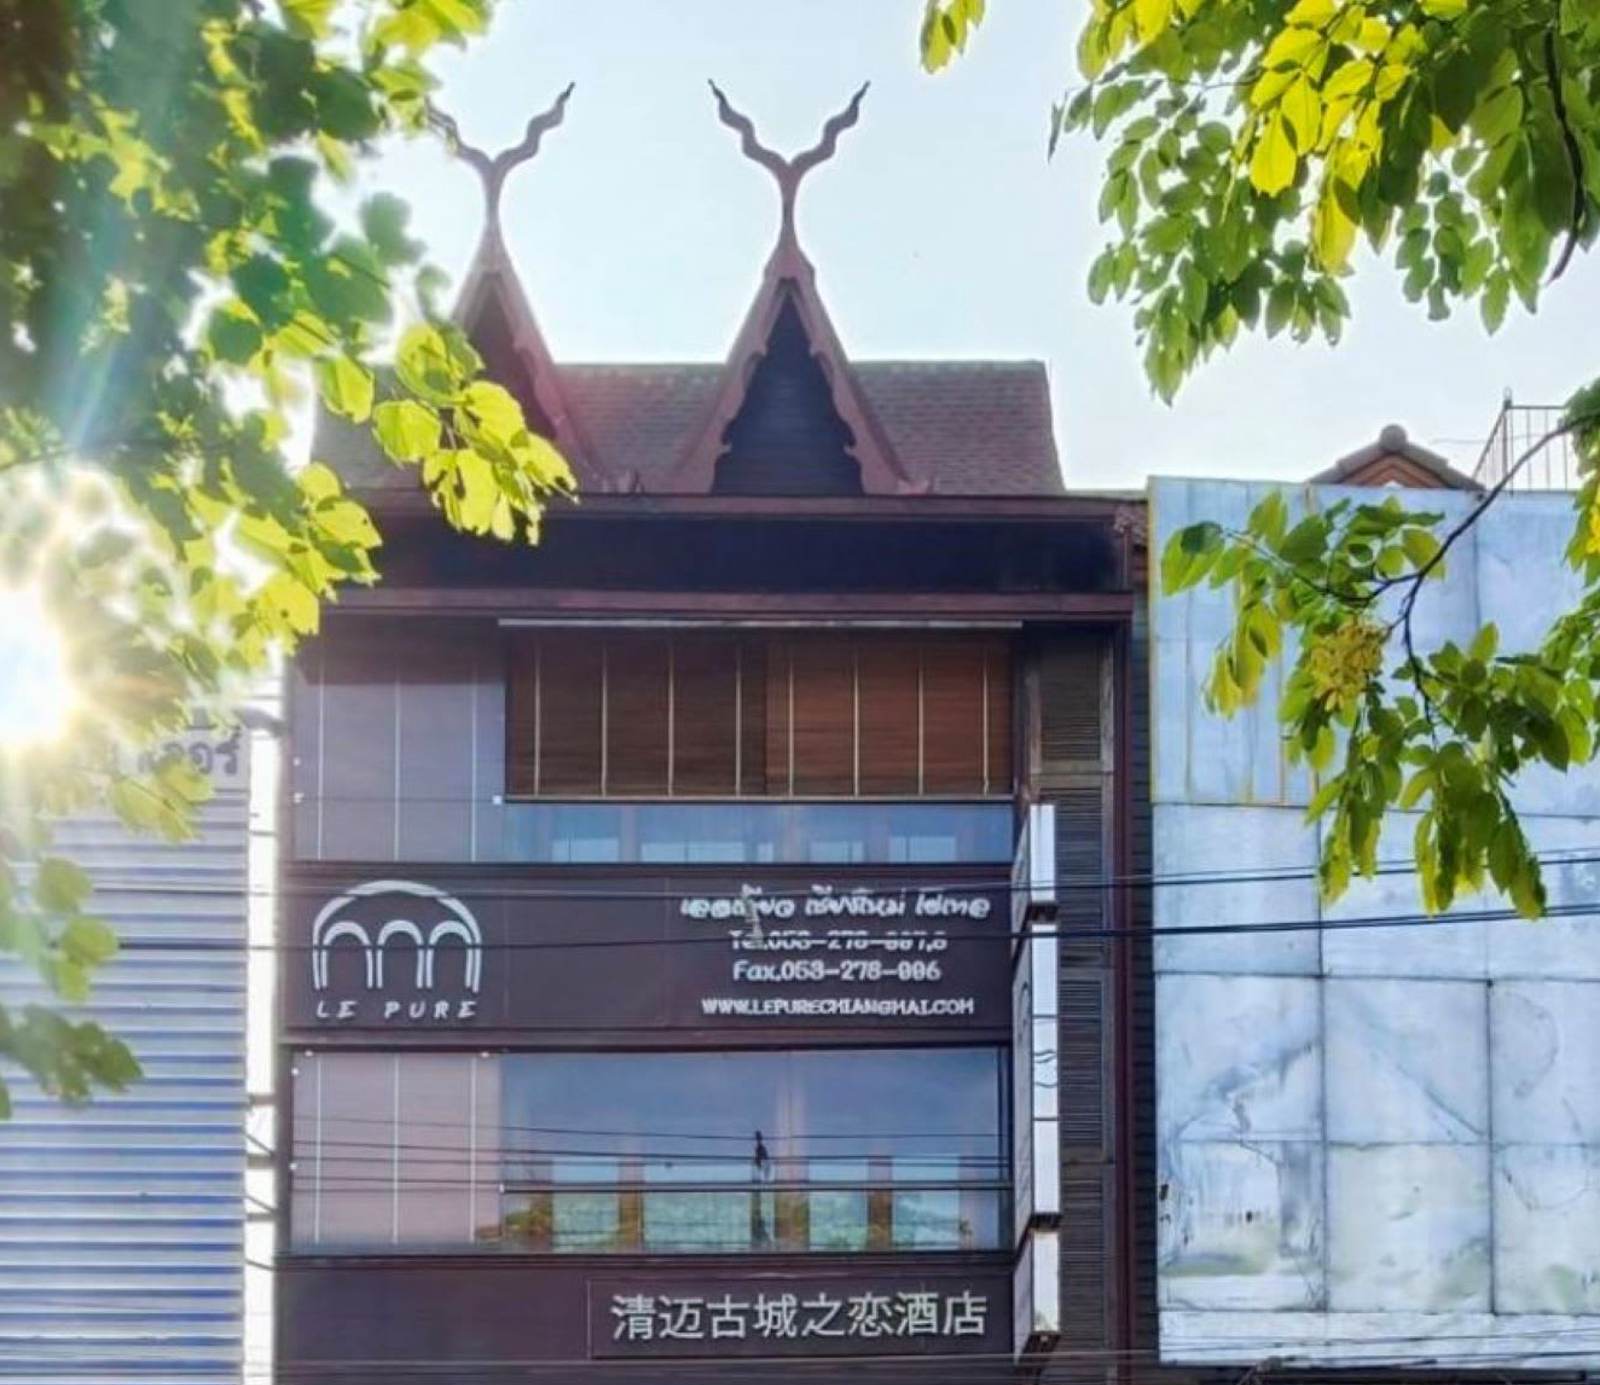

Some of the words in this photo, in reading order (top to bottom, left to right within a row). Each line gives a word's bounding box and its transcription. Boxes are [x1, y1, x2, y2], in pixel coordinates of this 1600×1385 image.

[315, 1000, 358, 1019] LE
[383, 1000, 477, 1019] PURE
[610, 1291, 988, 1341] 清迈古城之恋酒店
